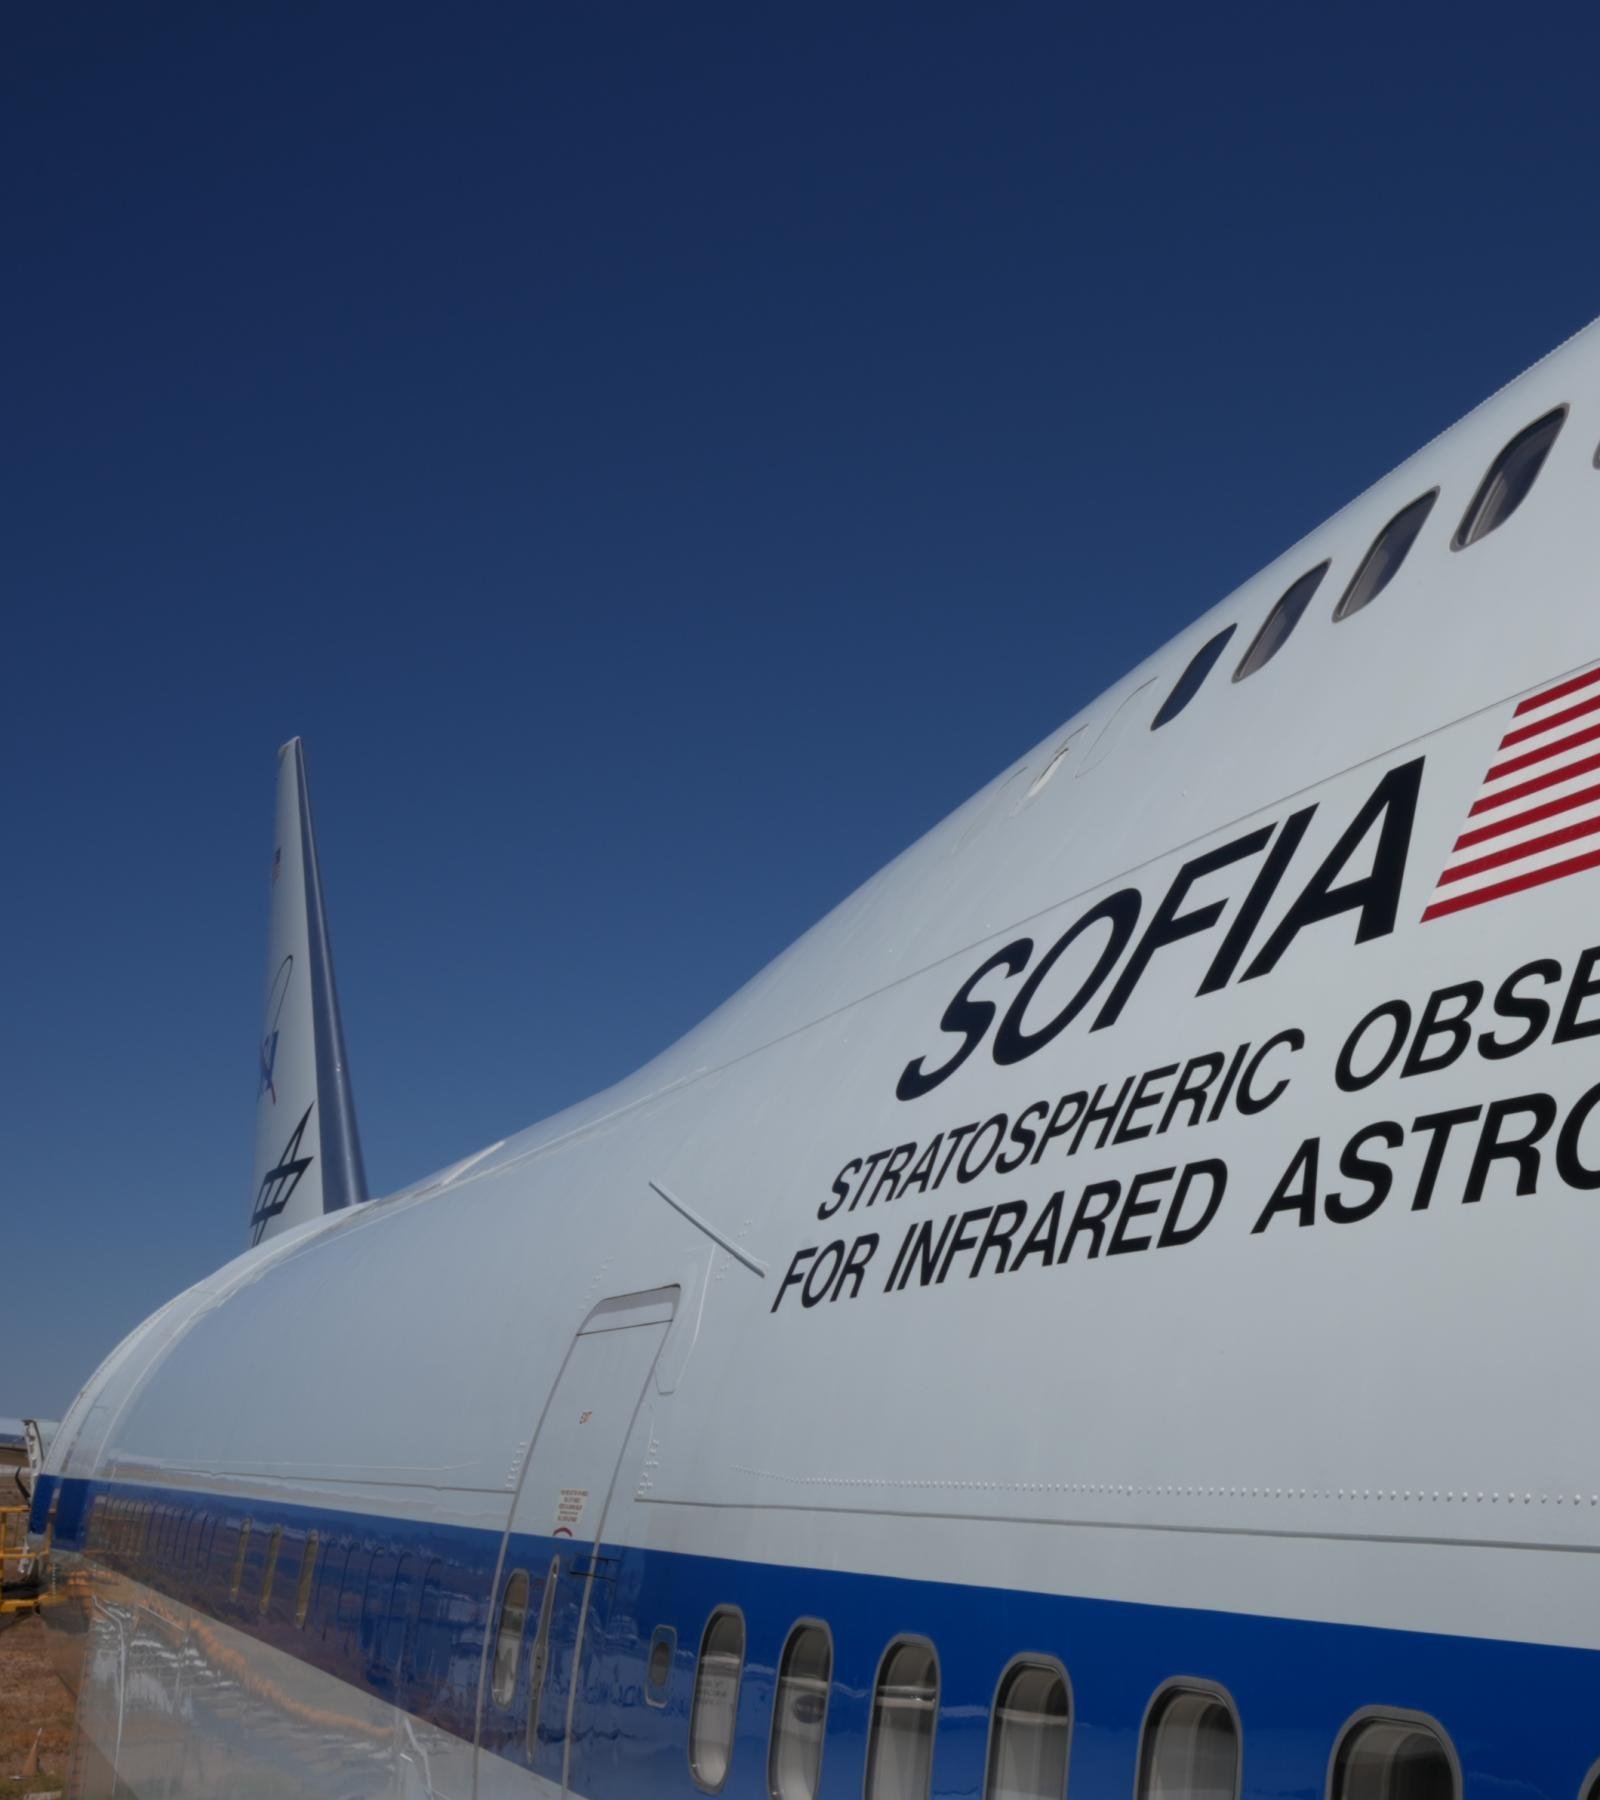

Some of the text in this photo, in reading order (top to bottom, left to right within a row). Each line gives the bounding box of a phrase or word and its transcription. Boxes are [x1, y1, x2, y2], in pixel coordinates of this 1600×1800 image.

[896, 757, 1425, 1101] SOFIA
[817, 1028, 1305, 1221] STRATOSPHERIC
[771, 1233, 880, 1313] FOR
[884, 1158, 1228, 1293] INFRARED
